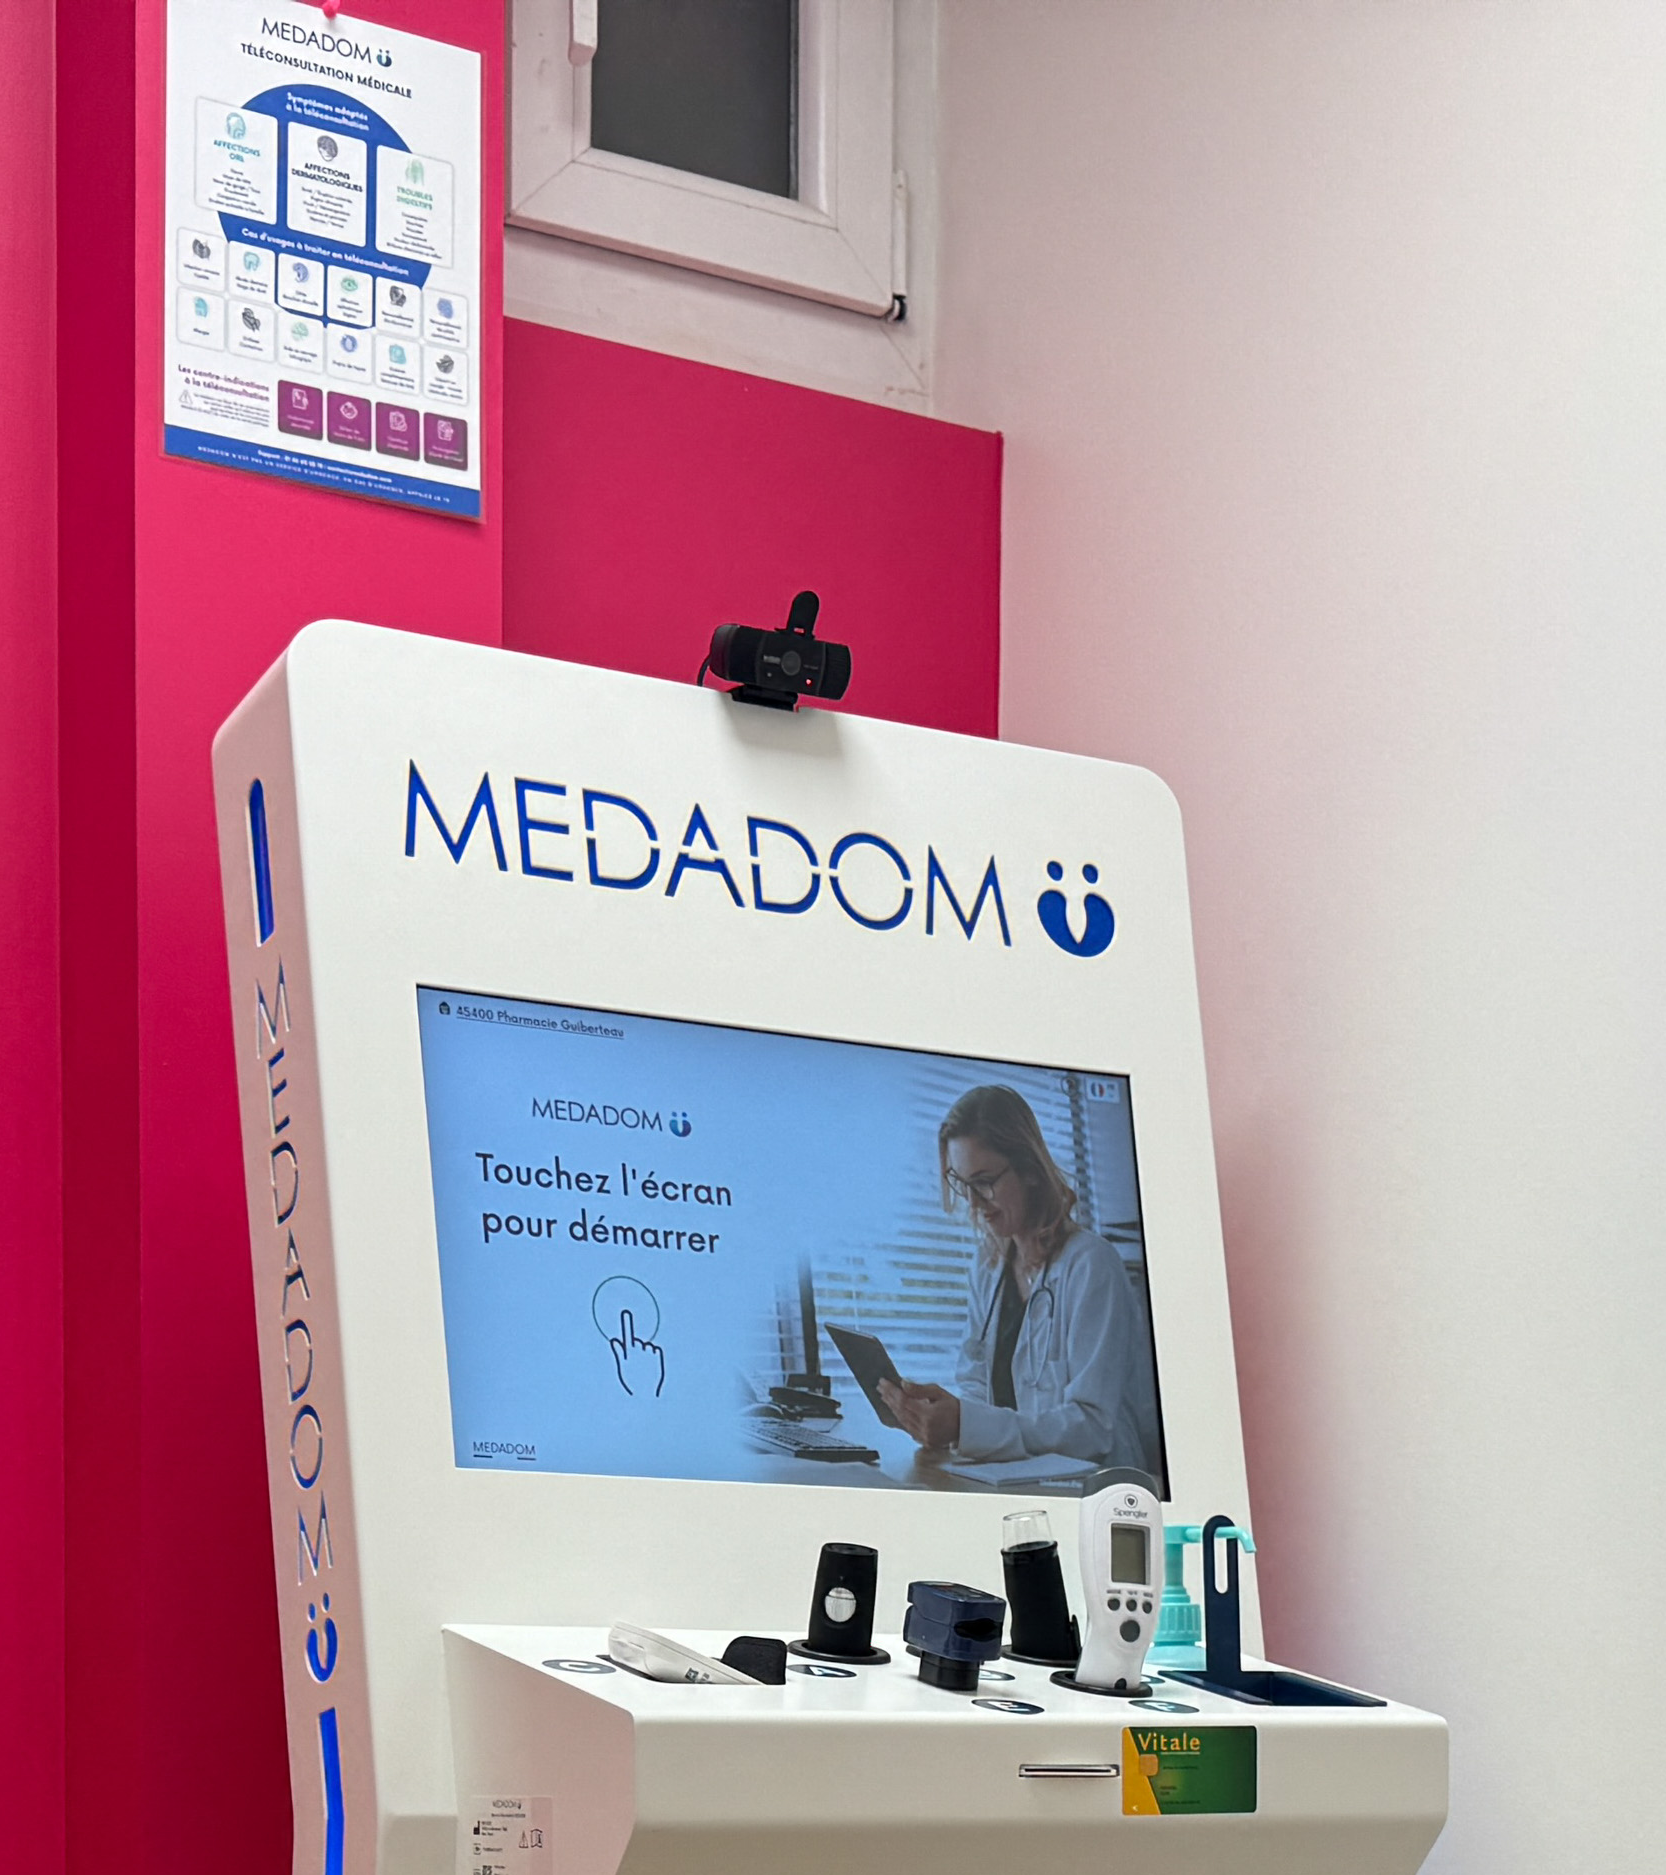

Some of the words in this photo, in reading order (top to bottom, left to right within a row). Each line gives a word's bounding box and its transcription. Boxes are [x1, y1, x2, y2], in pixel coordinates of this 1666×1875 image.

[261, 17, 372, 64] MEDADOM
[240, 42, 354, 82] TÉLÉCONSULTATION
[357, 73, 413, 99] MÉDICALE
[304, 162, 351, 180] AFFECTIONS
[404, 757, 1013, 948] MEDADOM
[456, 1005, 494, 1021] 45400
[497, 1011, 558, 1029] Pharmacie
[560, 1019, 624, 1038] Guiberteau
[532, 1097, 663, 1132] MEDADOM
[475, 1152, 611, 1194] Touchez
[621, 1162, 732, 1206] l'écran
[482, 1212, 557, 1244] pour
[568, 1207, 720, 1253] démarrer
[254, 952, 335, 1588] MEDADOM
[473, 1441, 536, 1455] MEDADOM
[1112, 1507, 1148, 1519] Spengler
[1138, 1732, 1201, 1751] Vitale
